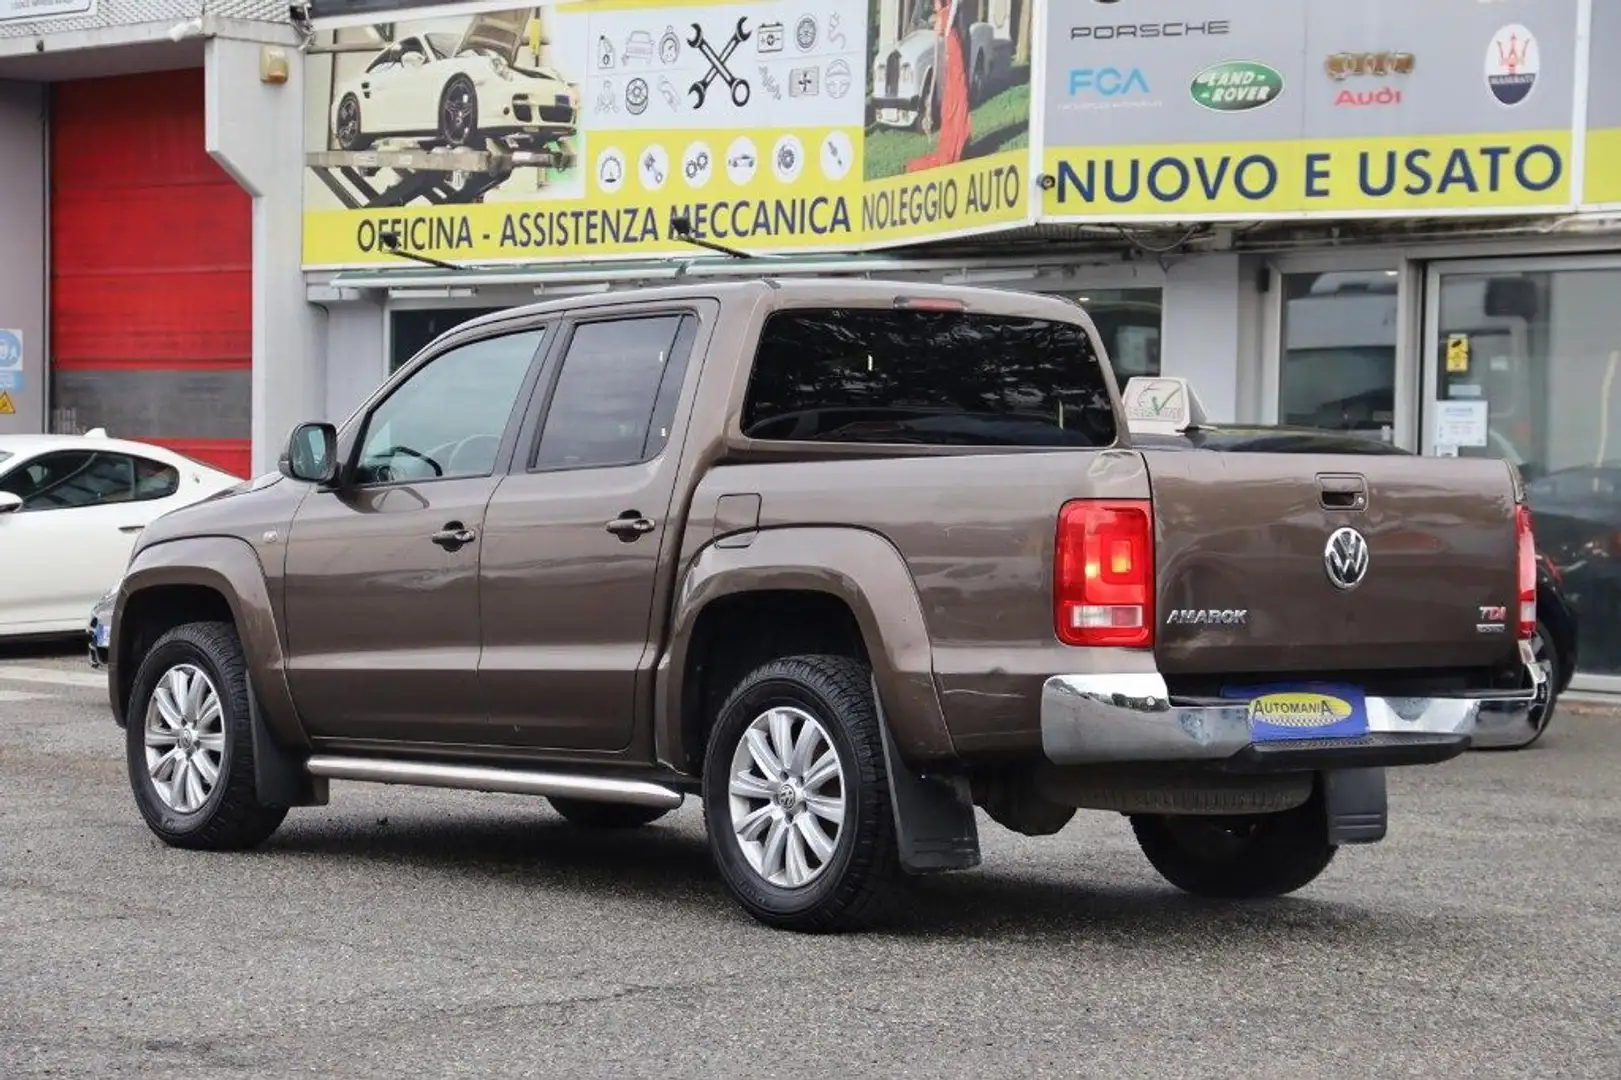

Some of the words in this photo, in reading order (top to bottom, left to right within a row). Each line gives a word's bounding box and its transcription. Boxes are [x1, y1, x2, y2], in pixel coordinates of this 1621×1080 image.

[1070, 20, 1230, 40] PORSCHE
[1068, 67, 1150, 96] FCA
[1057, 154, 1278, 203] NUOVO
[1305, 153, 1331, 197] E
[1359, 144, 1563, 197] USATO
[862, 178, 957, 232] NOLEGGIO
[965, 164, 1020, 215] AUTO
[357, 216, 473, 252] OFFICINA
[500, 207, 659, 248] ASSISTENZA
[668, 196, 851, 241] MECCANICA
[1166, 609, 1248, 624] AMAROK
[1479, 606, 1506, 620] TDI
